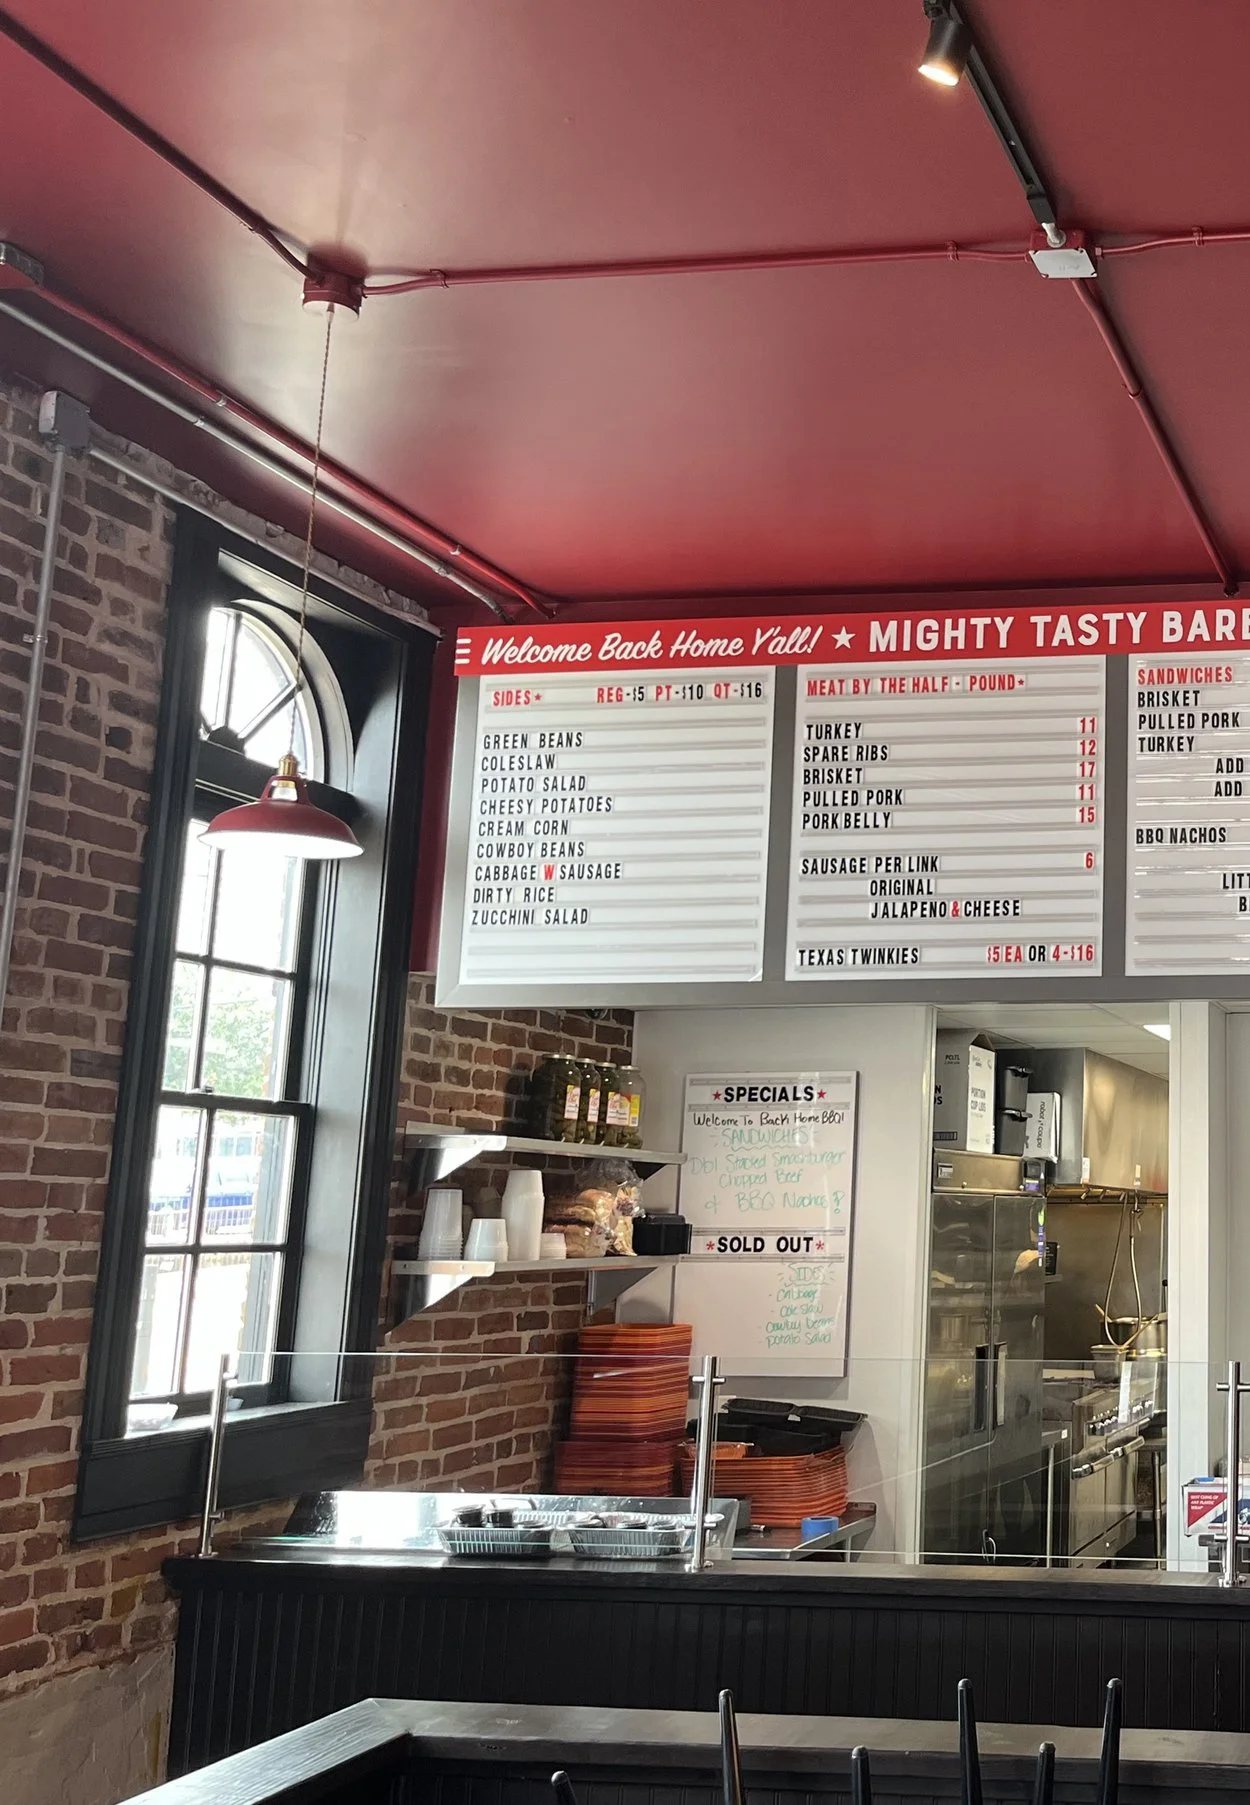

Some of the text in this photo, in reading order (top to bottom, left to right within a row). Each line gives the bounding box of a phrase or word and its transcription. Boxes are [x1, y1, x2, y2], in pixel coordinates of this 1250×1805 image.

[868, 616, 1015, 652] MIGHTY
[1029, 611, 1147, 648] TASTY
[481, 625, 823, 665] Welcome Back Home Y'all!
[1137, 666, 1233, 685] SANDWICHES
[493, 682, 762, 706] SIDES REG-$5 PT-$10 QT-$16
[807, 679, 845, 696] MEAT
[852, 678, 871, 695] BY
[880, 677, 906, 694] THE
[969, 674, 1015, 691] POUND
[1137, 690, 1200, 707] BRISKET
[806, 717, 1096, 740] TURKEY 11
[1138, 713, 1195, 730] PULLED
[1201, 712, 1240, 729] PORK
[484, 732, 582, 749] GREEN BEANS
[1138, 736, 1195, 752] TURKEY
[803, 739, 1096, 762] SPARE RIBS 12
[482, 754, 556, 771] COLESLAW
[1215, 757, 1244, 774] ADD
[803, 761, 1096, 785] BRISKET 17
[482, 775, 586, 793] POTATO SALAD
[1214, 780, 1242, 797] ADD
[803, 784, 1095, 807] PULLED PORK 11
[480, 797, 613, 815] CHEESY POTATOES
[1079, 807, 1095, 823] 15
[478, 820, 568, 836] CREAM CORN
[1136, 828, 1164, 845] BBQ
[1170, 827, 1227, 844] NACHOS
[477, 842, 585, 858] COWBOY BEANS
[475, 863, 621, 881] CABBAGE W SAUSAGE
[801, 852, 1093, 875] SAUSAGE PER LINK 6
[473, 887, 554, 903] DIRTY RICE
[870, 879, 933, 896] ORIGINAL
[472, 909, 588, 925] ZUCCHINI SALAD
[871, 900, 1021, 919] JALAPENO CHEESE
[798, 949, 844, 966] TEXAS
[851, 948, 919, 965] TWINKIES
[1005, 946, 1022, 962] EA
[1028, 945, 1046, 962] OR
[724, 1086, 814, 1103] SPECIALS
[693, 1113, 739, 1126] Welcome
[740, 1114, 753, 1126] To
[760, 1112, 789, 1126] Back
[794, 1112, 819, 1124] Home
[717, 1237, 814, 1253] SOLD OUT
